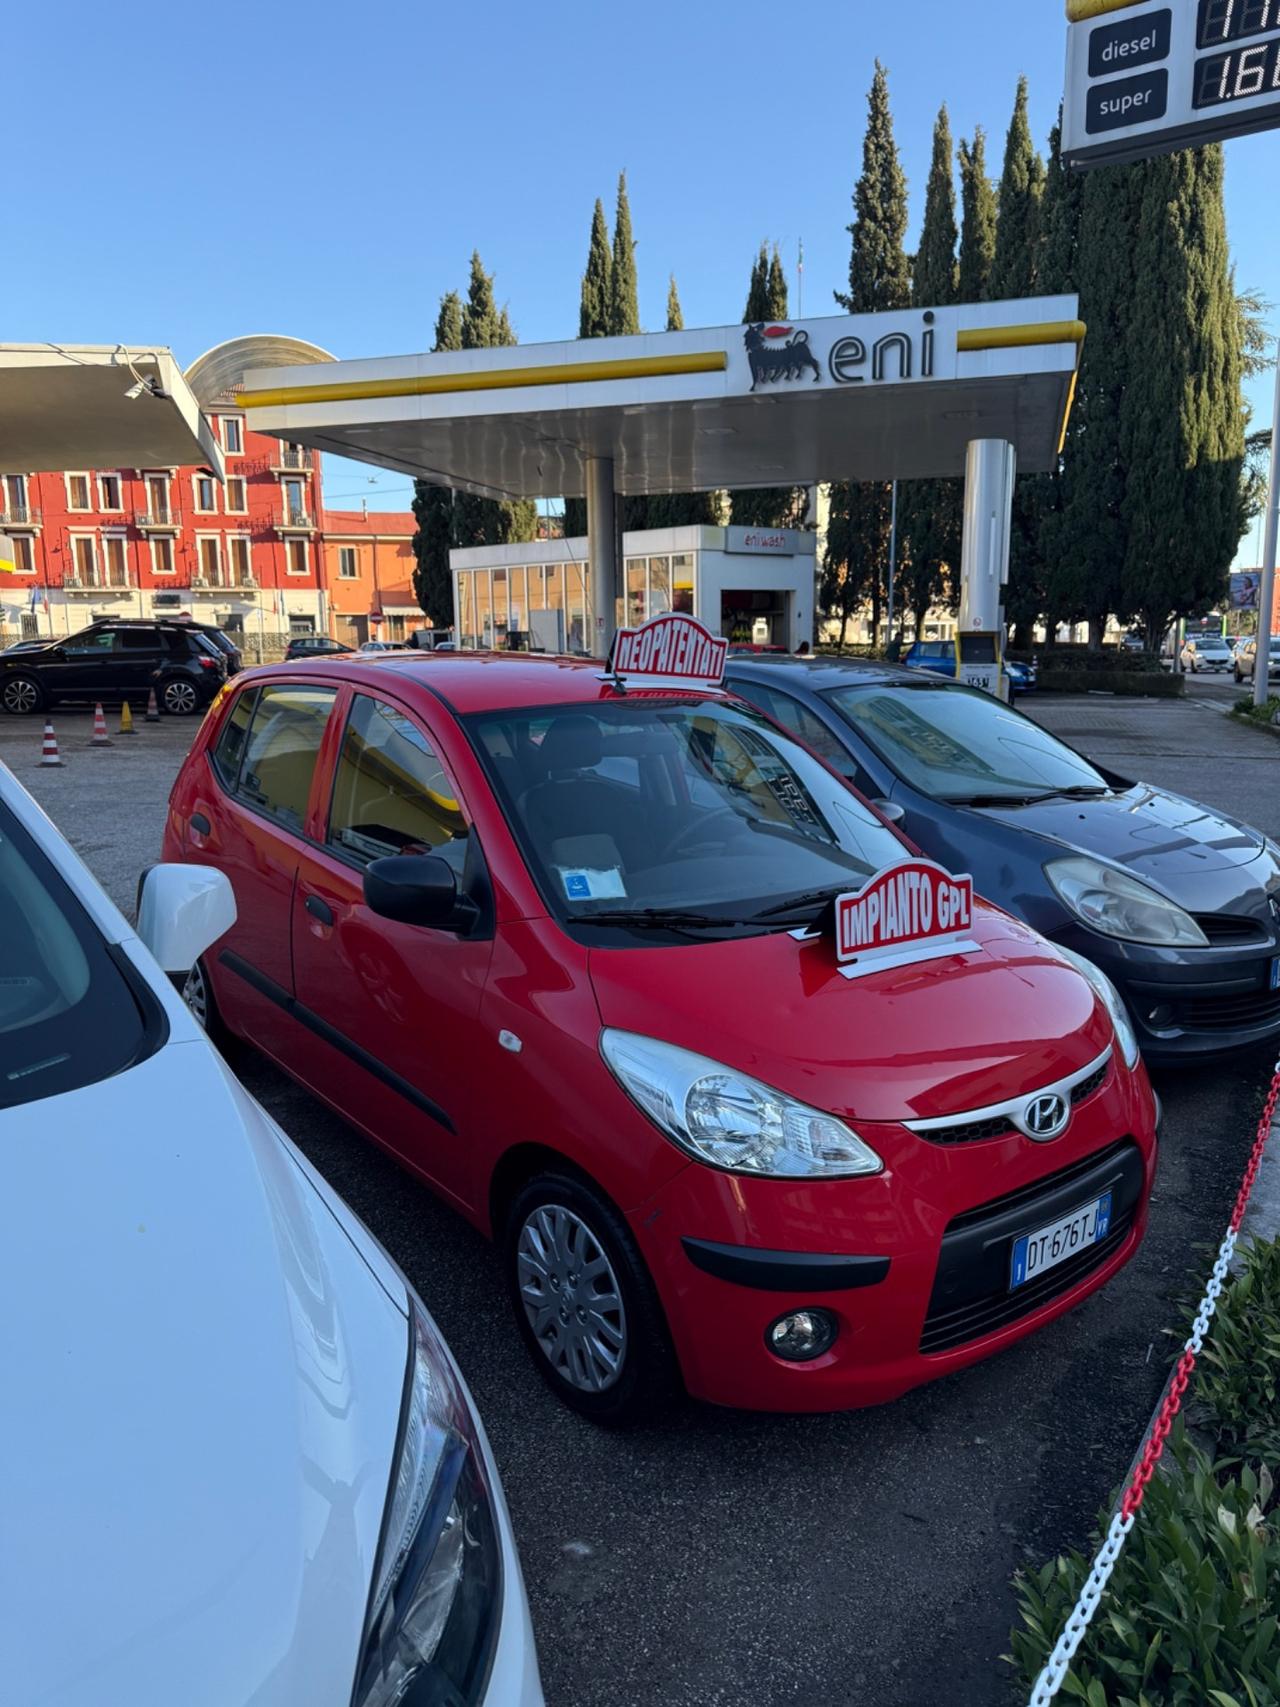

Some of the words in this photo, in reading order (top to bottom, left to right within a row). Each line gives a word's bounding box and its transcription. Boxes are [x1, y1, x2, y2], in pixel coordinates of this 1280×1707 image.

[1101, 29, 1157, 62] diesel
[1099, 89, 1153, 115] super
[828, 310, 935, 383] eni
[617, 618, 724, 677] NEOPATENTATI
[843, 871, 933, 949] IMPIANTO
[937, 881, 969, 930] GPL
